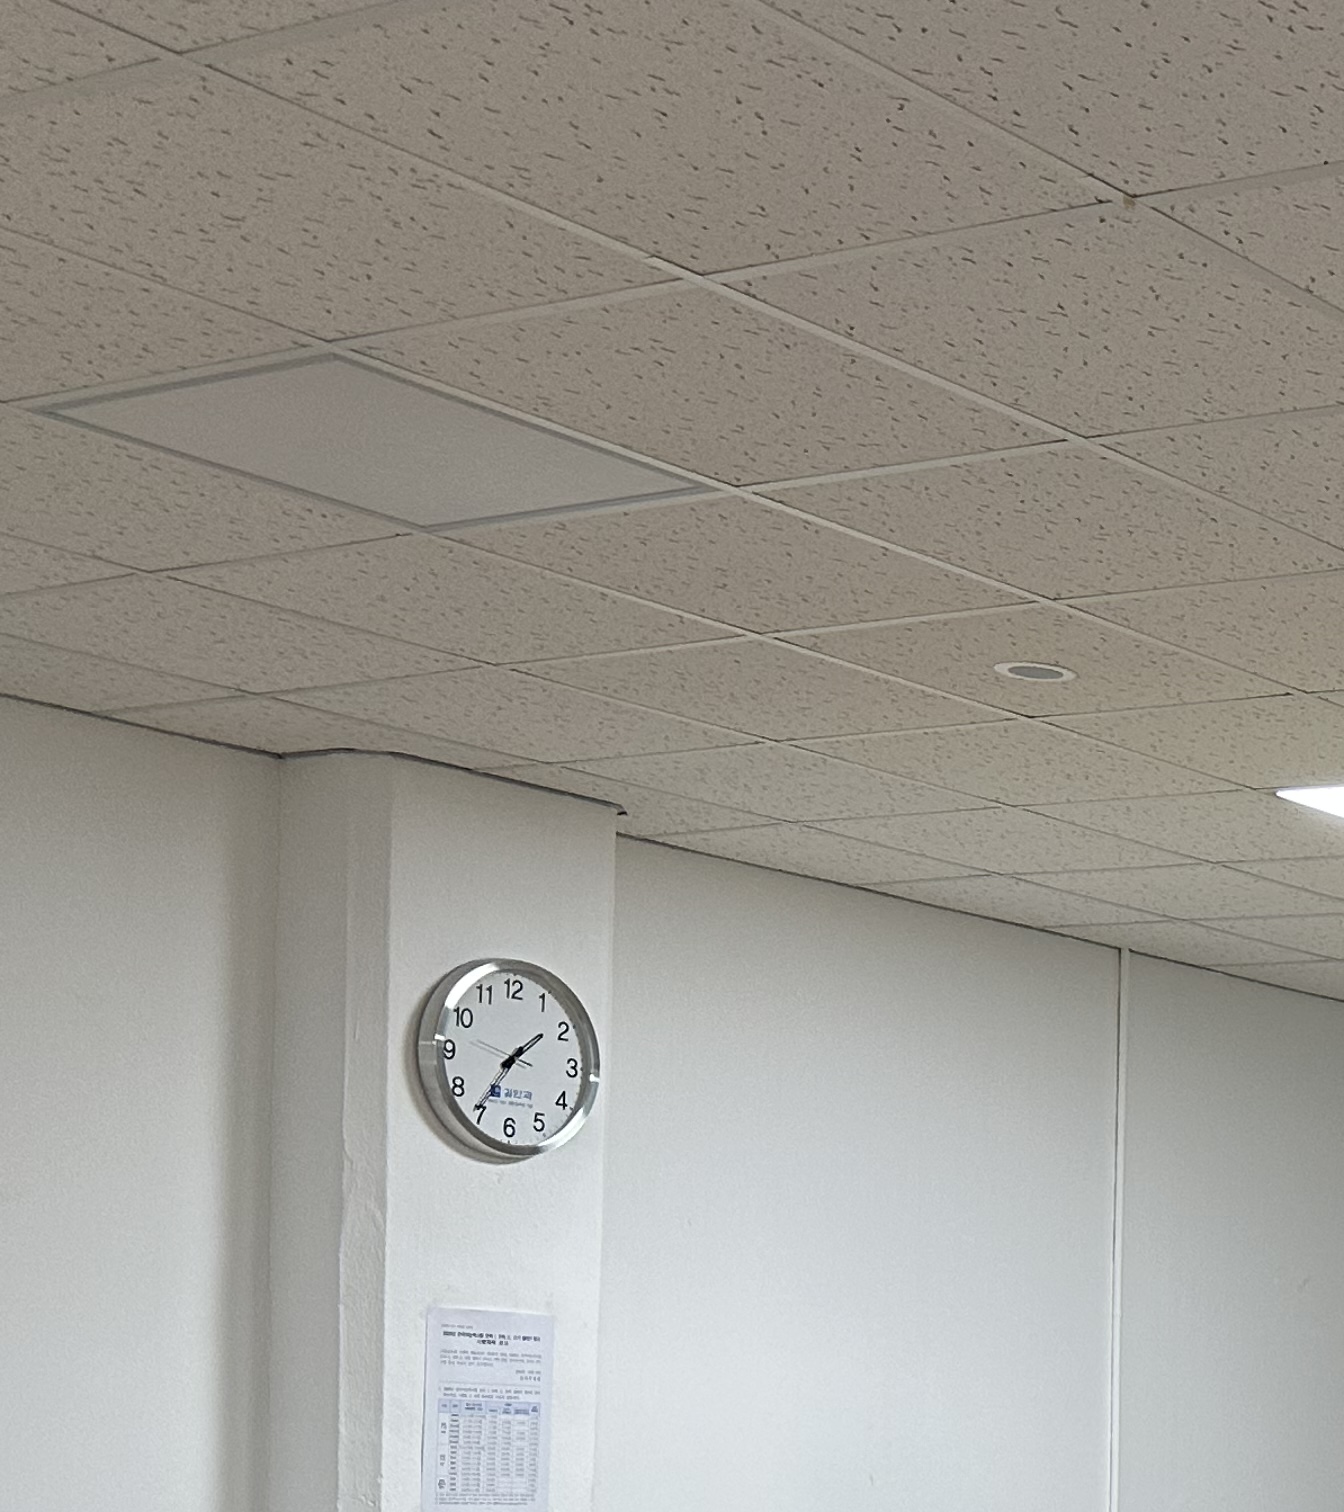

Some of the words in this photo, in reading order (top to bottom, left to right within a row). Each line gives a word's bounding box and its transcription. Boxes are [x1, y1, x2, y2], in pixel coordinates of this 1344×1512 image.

[476, 984, 493, 1005] 11
[504, 978, 524, 1000] 12
[538, 993, 546, 1012] 1
[453, 1007, 474, 1029] 10
[557, 1021, 570, 1042] 2
[443, 1039, 456, 1060] 9
[565, 1058, 578, 1078] 3
[452, 1076, 465, 1097] 8
[555, 1090, 568, 1111] 4
[476, 1105, 487, 1125] 7
[532, 1112, 546, 1132] 5
[503, 1117, 516, 1138] 6
